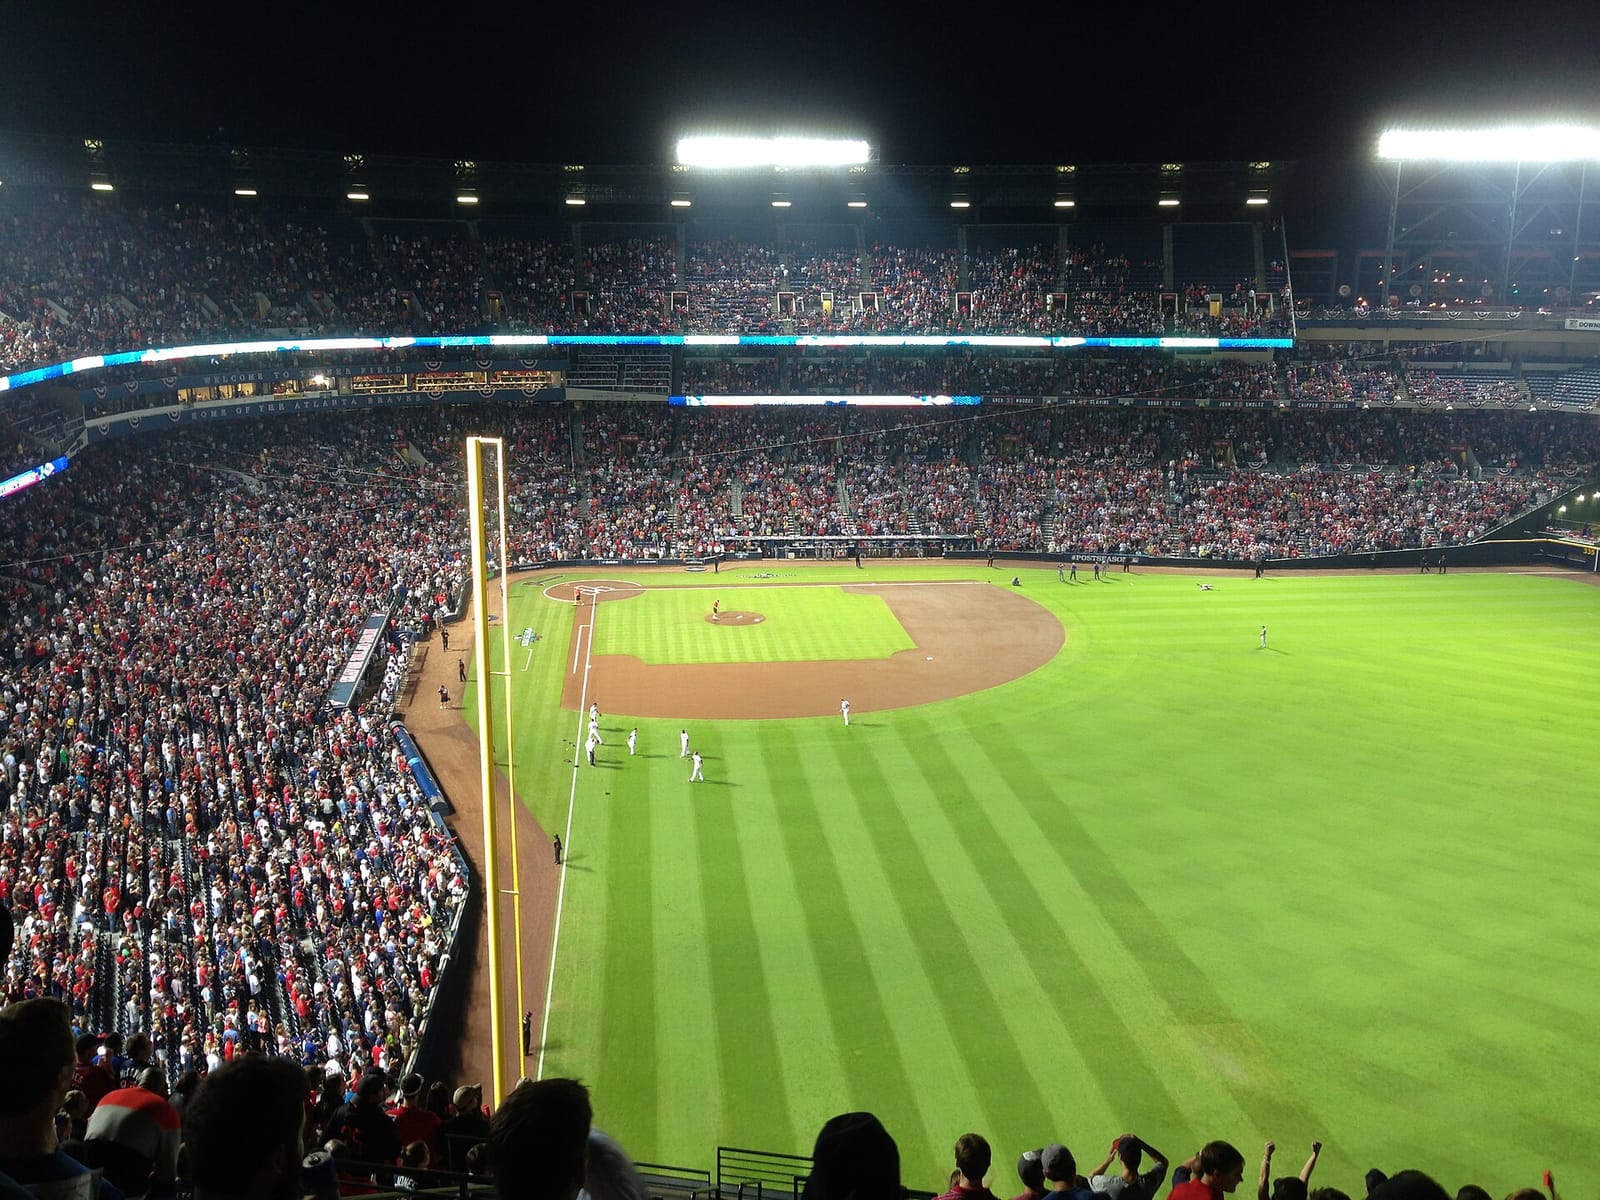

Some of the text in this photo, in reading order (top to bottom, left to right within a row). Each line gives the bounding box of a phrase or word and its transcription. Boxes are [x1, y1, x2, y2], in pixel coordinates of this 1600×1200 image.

[204, 369, 264, 385] WELCOME
[274, 371, 290, 380] TO
[361, 366, 403, 375] FIELD
[191, 395, 422, 420] HOME OF THE ATLANTA BRAVES
